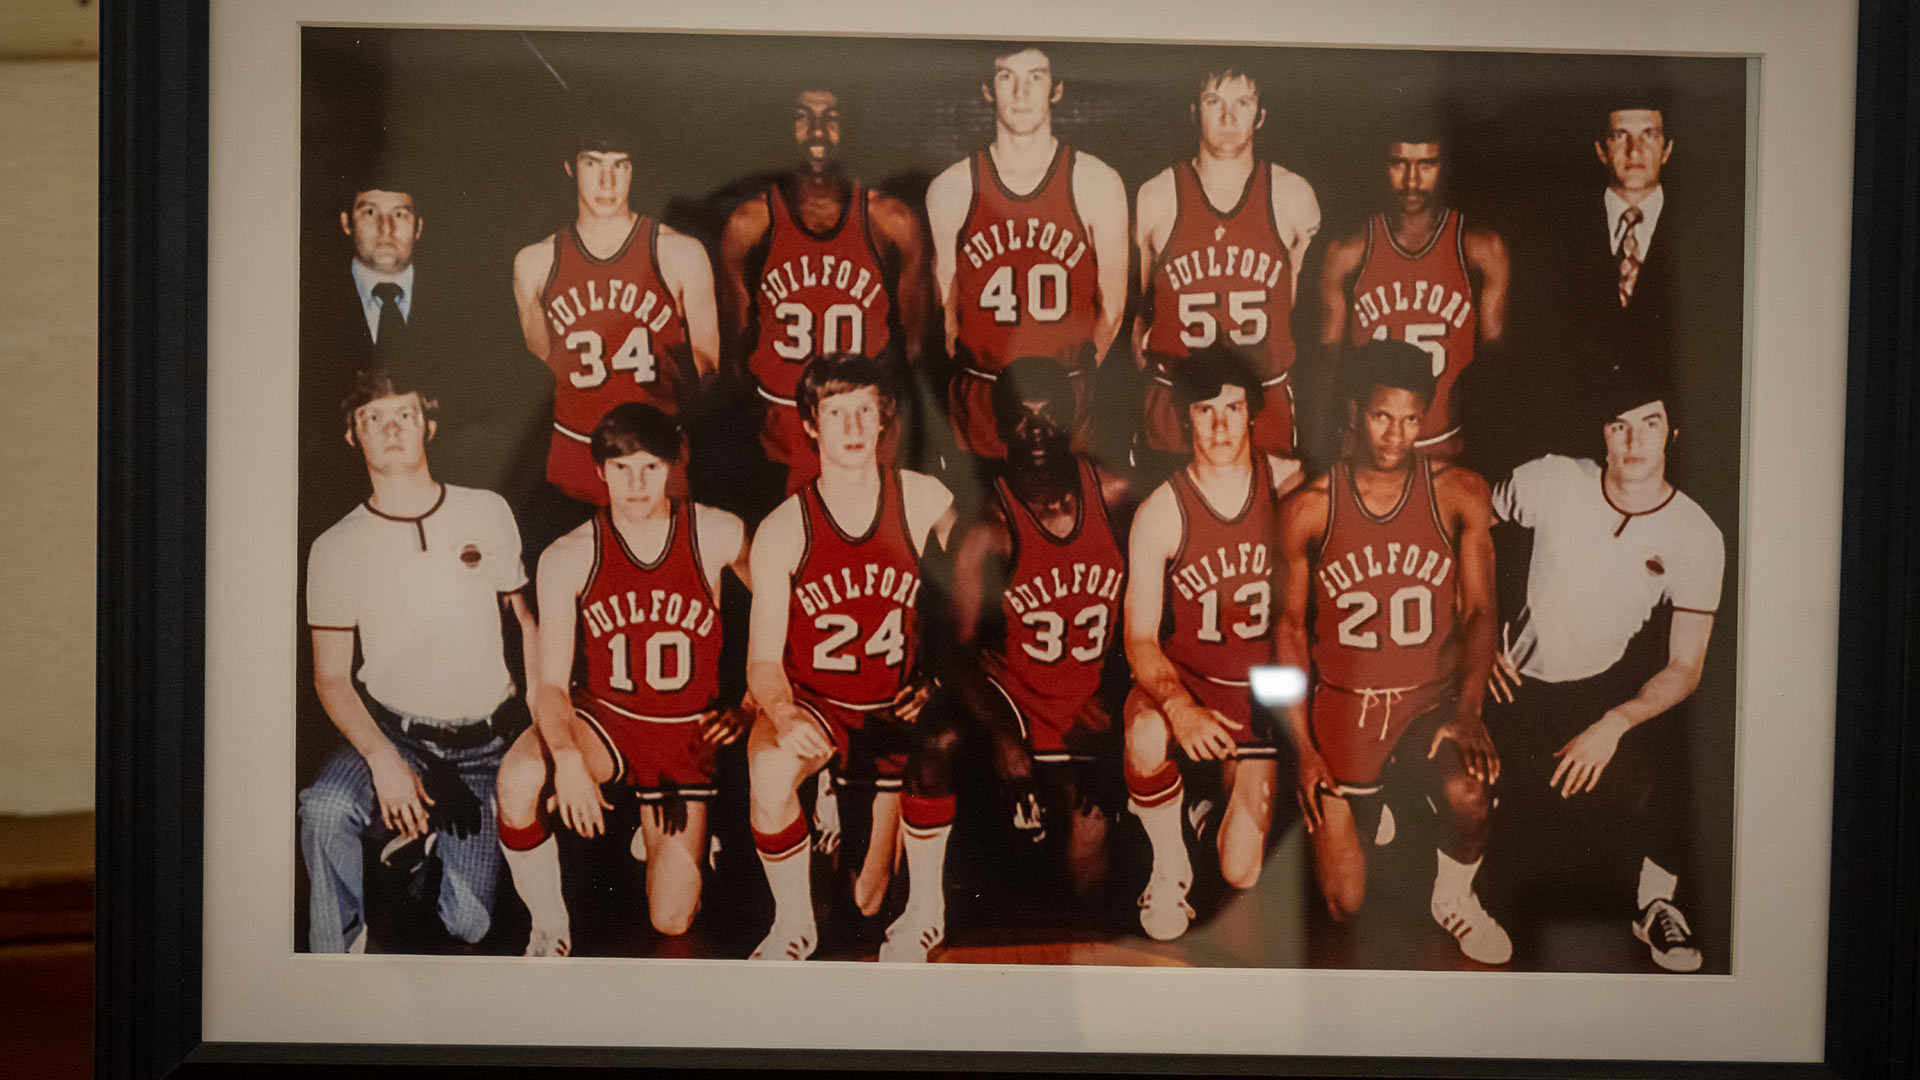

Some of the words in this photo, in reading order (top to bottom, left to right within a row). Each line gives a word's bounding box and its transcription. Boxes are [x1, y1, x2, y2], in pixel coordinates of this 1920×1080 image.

[964, 218, 1086, 269] GUILFORD
[980, 263, 1067, 322] 40
[1179, 290, 1267, 348] 55
[565, 327, 656, 389] 34
[773, 302, 862, 360] 30
[1172, 542, 1272, 600] GUILFO
[812, 608, 904, 671] 24
[1021, 603, 1108, 662] 33
[1197, 580, 1270, 642] 13
[1336, 585, 1433, 648] 20
[608, 631, 690, 691] 10
